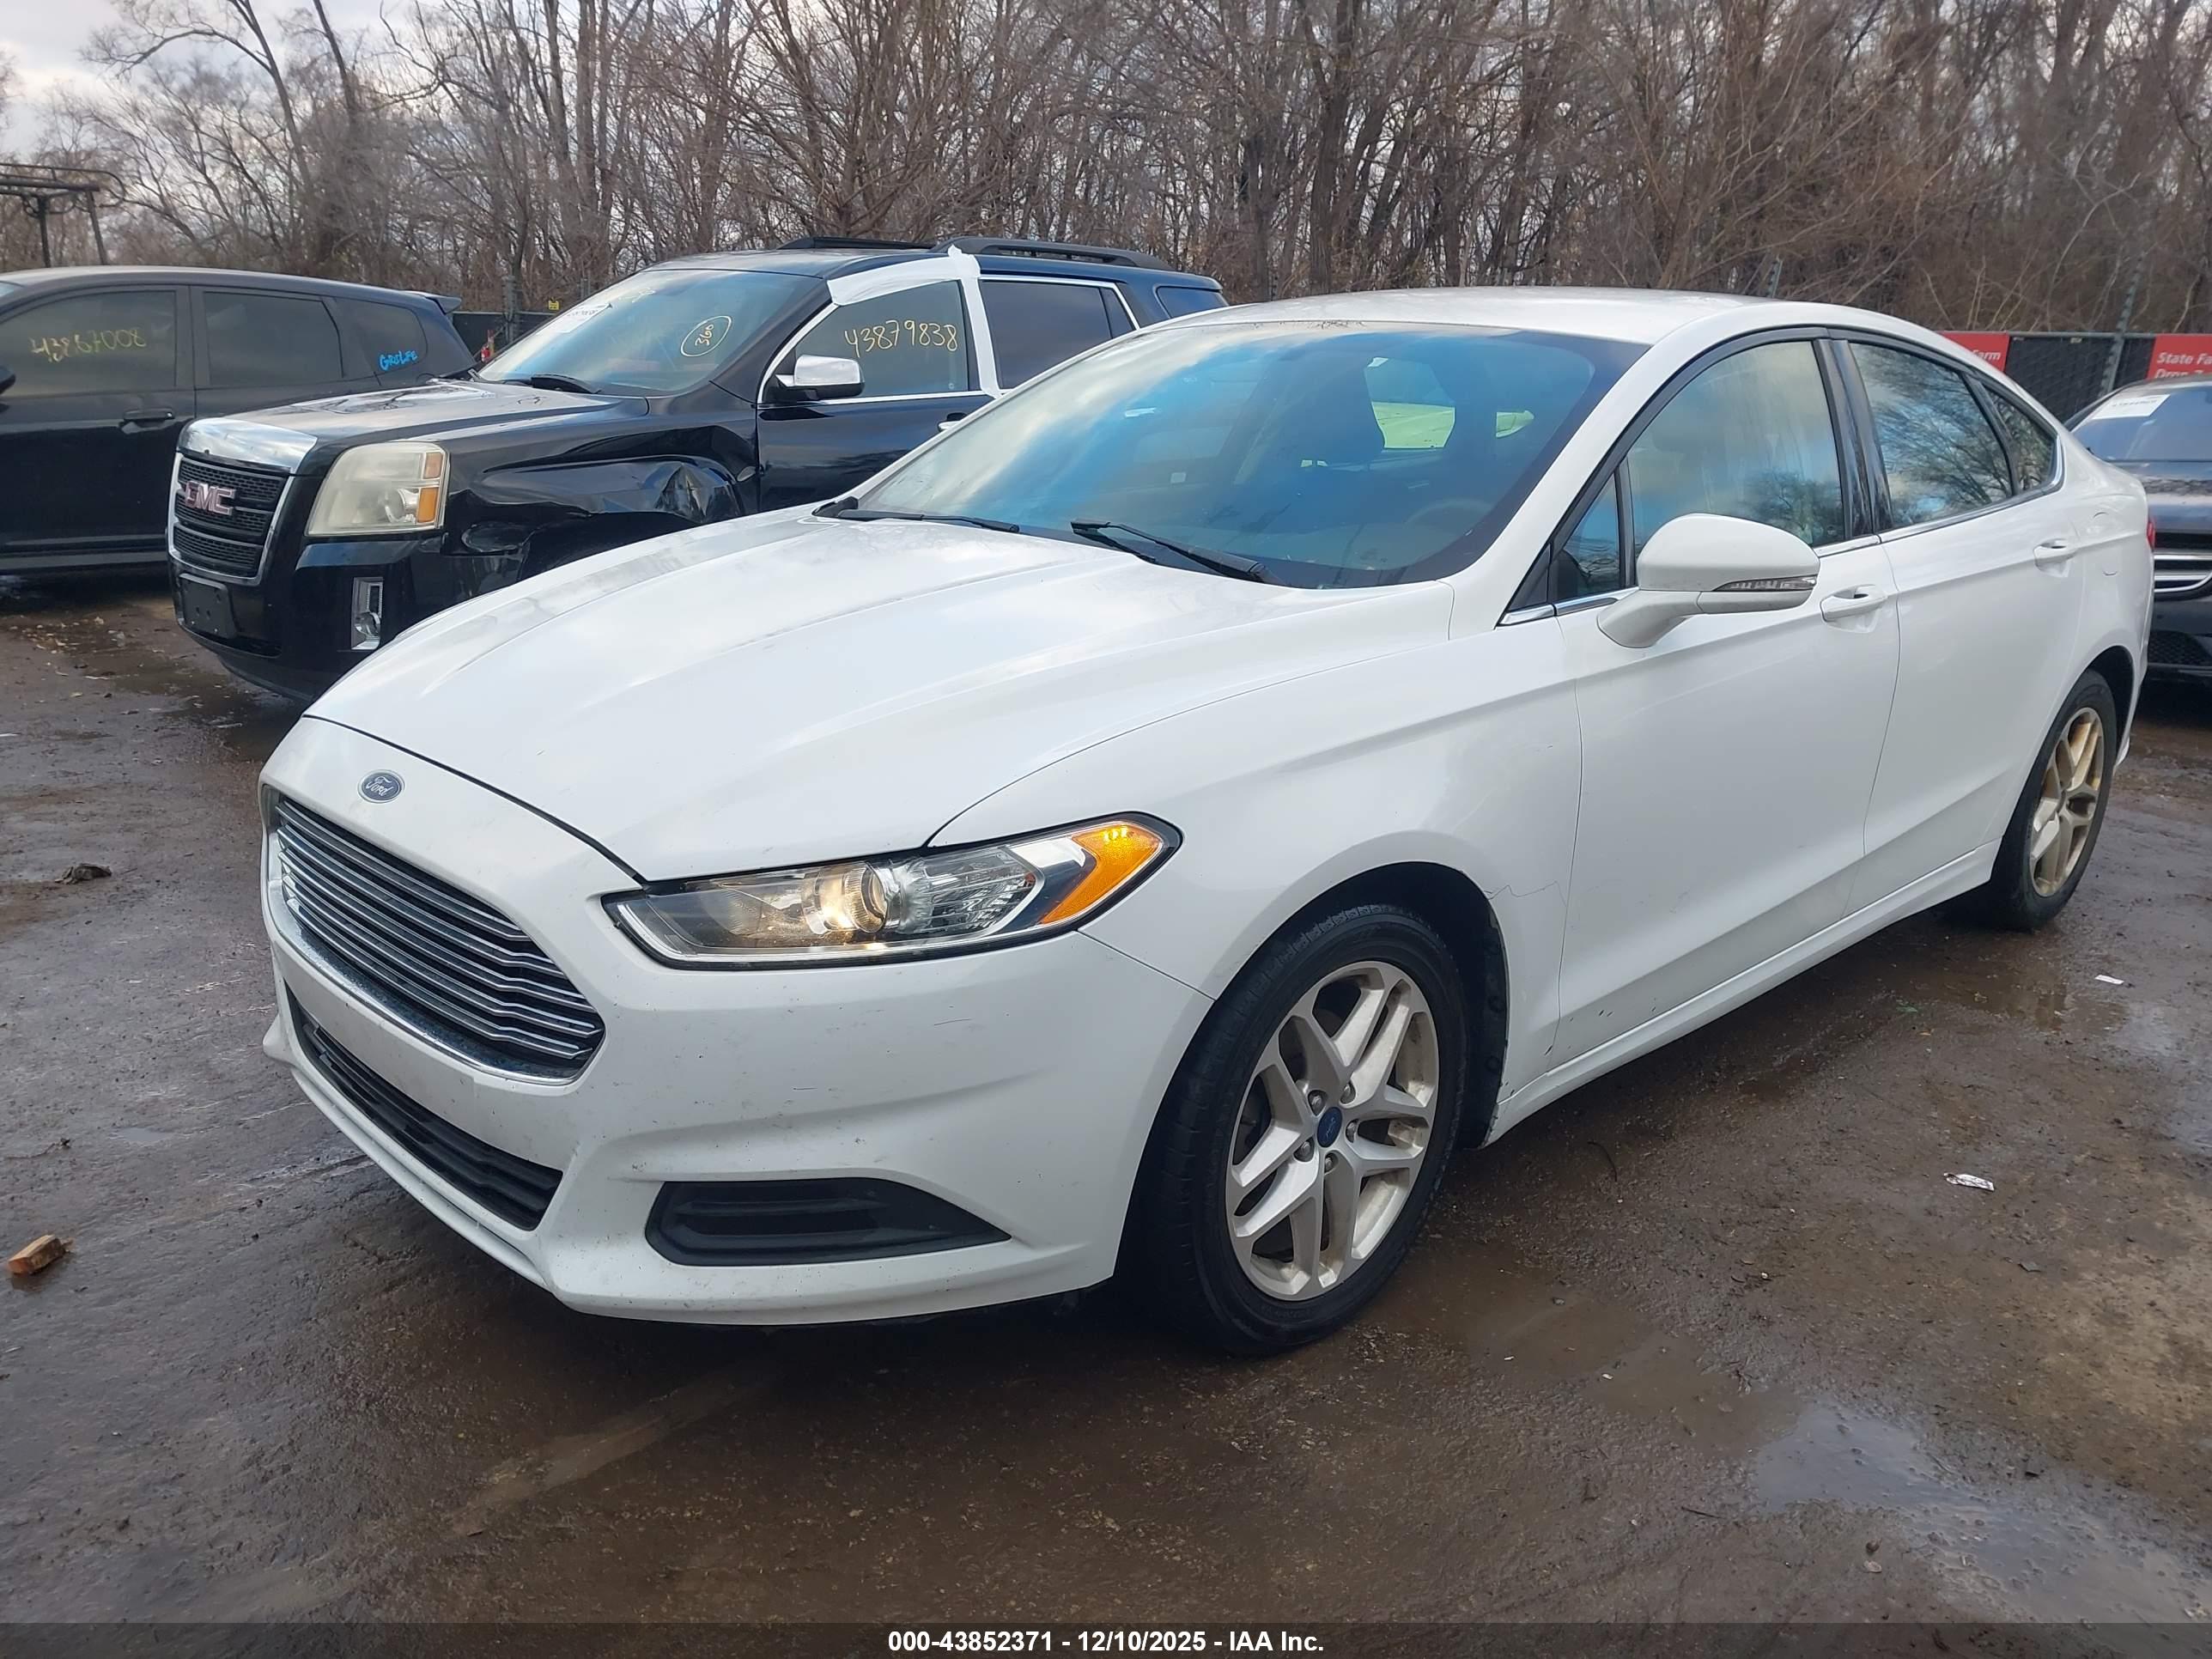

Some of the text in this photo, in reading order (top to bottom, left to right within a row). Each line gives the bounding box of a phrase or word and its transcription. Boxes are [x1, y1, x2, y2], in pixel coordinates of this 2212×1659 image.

[844, 319, 958, 358] 43879838
[2156, 351, 2194, 364] State
[185, 480, 236, 516] GMC
